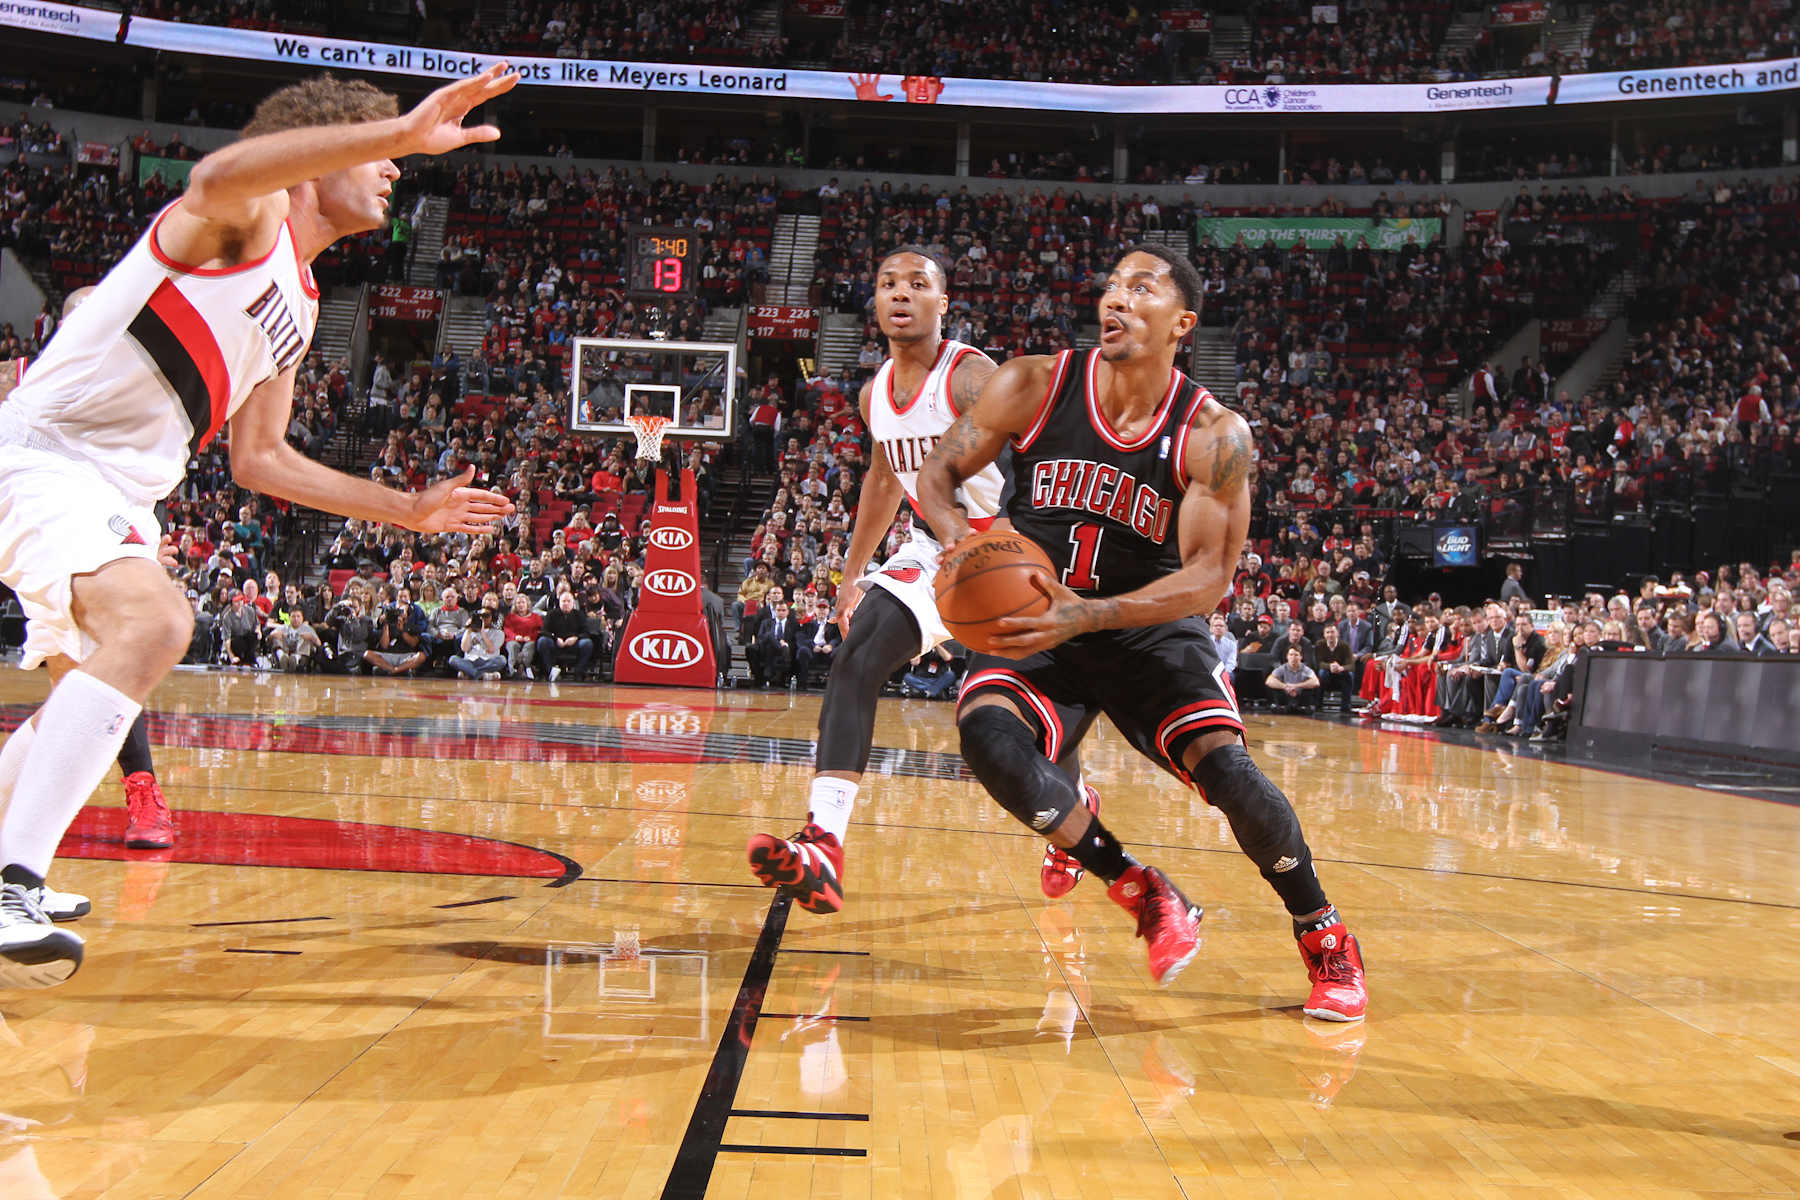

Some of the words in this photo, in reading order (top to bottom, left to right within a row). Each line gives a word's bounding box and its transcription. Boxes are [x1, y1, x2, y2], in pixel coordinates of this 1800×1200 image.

[274, 37, 309, 58] We
[320, 45, 376, 65] can't
[386, 50, 412, 69] all
[423, 53, 483, 75] block
[561, 62, 599, 81] like
[610, 65, 688, 90] Meyers
[699, 70, 787, 91] Leonard
[1618, 68, 1744, 94] Genentech
[1756, 62, 1799, 86] and
[1224, 89, 1260, 105] CCA
[1427, 83, 1512, 100] Genentech
[1240, 228, 1266, 241] FOR
[1270, 228, 1296, 241] THE
[651, 237, 688, 257] 7:40
[654, 258, 682, 292] 13
[380, 287, 401, 297] 222
[412, 289, 433, 300] 223
[380, 306, 396, 316] 116
[416, 308, 432, 319] 117
[758, 307, 779, 317] 223
[789, 308, 810, 319] 224
[757, 326, 774, 336] 117
[1032, 459, 1173, 545] CHICAGO
[656, 531, 687, 546] KIA
[1446, 535, 1469, 545] BUD
[1062, 521, 1104, 591] 1
[1442, 543, 1472, 553] LIGHT
[653, 574, 688, 591] KIA
[642, 637, 691, 662] KIA
